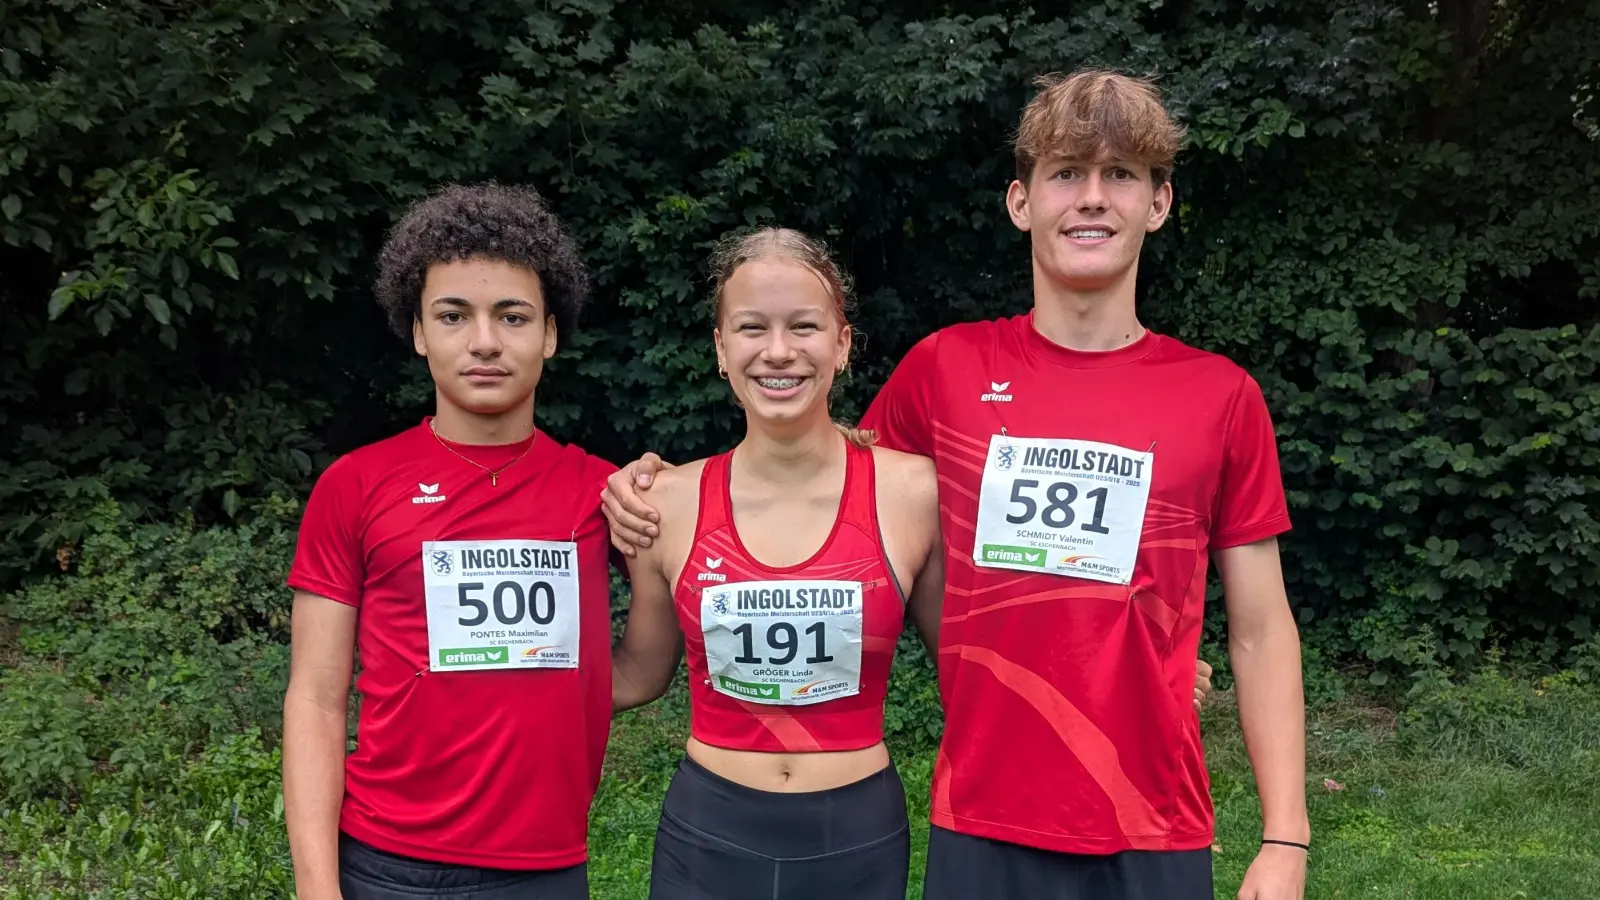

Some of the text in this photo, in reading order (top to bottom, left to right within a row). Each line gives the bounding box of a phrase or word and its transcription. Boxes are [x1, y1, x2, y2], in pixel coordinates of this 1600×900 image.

[981, 393, 1013, 402] erima
[1023, 447, 1145, 479] INGOLSTADT
[1020, 468, 1053, 476] Bayerische
[1054, 470, 1094, 480] Meisterschaft
[1125, 479, 1141, 487] 2025
[412, 495, 446, 504] erima
[1006, 479, 1110, 535] 581
[1016, 529, 1094, 546] SCHMIDT Valentin
[1038, 541, 1076, 551] ESCHENBACH
[461, 548, 571, 570] INGOLSTADT
[987, 550, 1023, 562] erima
[1081, 562, 1120, 574] M&M SPORTS
[697, 571, 727, 582] erima
[458, 580, 556, 627] 500
[737, 588, 855, 610] INGOLSTADT
[470, 630, 548, 639] PONTES Maximilian
[732, 621, 834, 665] 191
[446, 652, 486, 664] erima
[753, 667, 814, 677] GRÖGER Linda
[725, 680, 758, 696] erima
[828, 682, 849, 691] SPORTS
